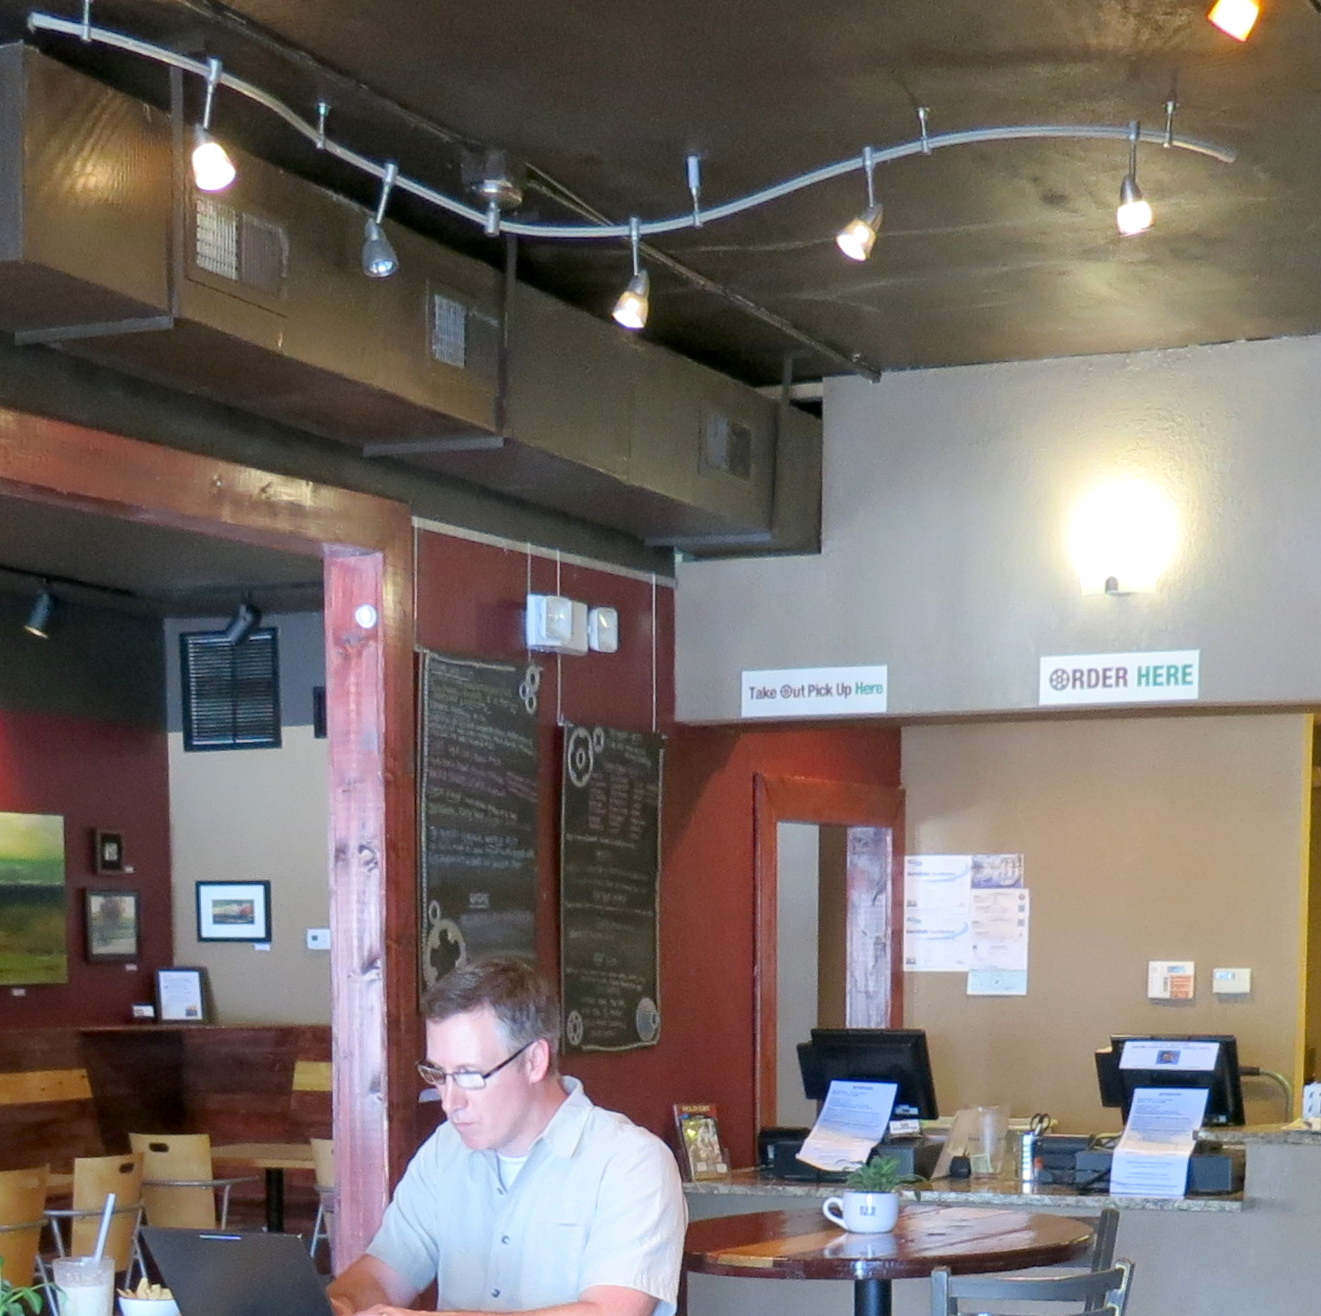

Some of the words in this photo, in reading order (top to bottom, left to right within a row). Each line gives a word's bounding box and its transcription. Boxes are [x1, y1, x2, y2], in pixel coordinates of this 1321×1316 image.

[1049, 666, 1128, 691] ORDER
[1136, 663, 1194, 687] HERE
[748, 686, 777, 700] Take
[808, 683, 833, 697] Pick
[836, 682, 852, 699] Up
[855, 681, 884, 695] Here
